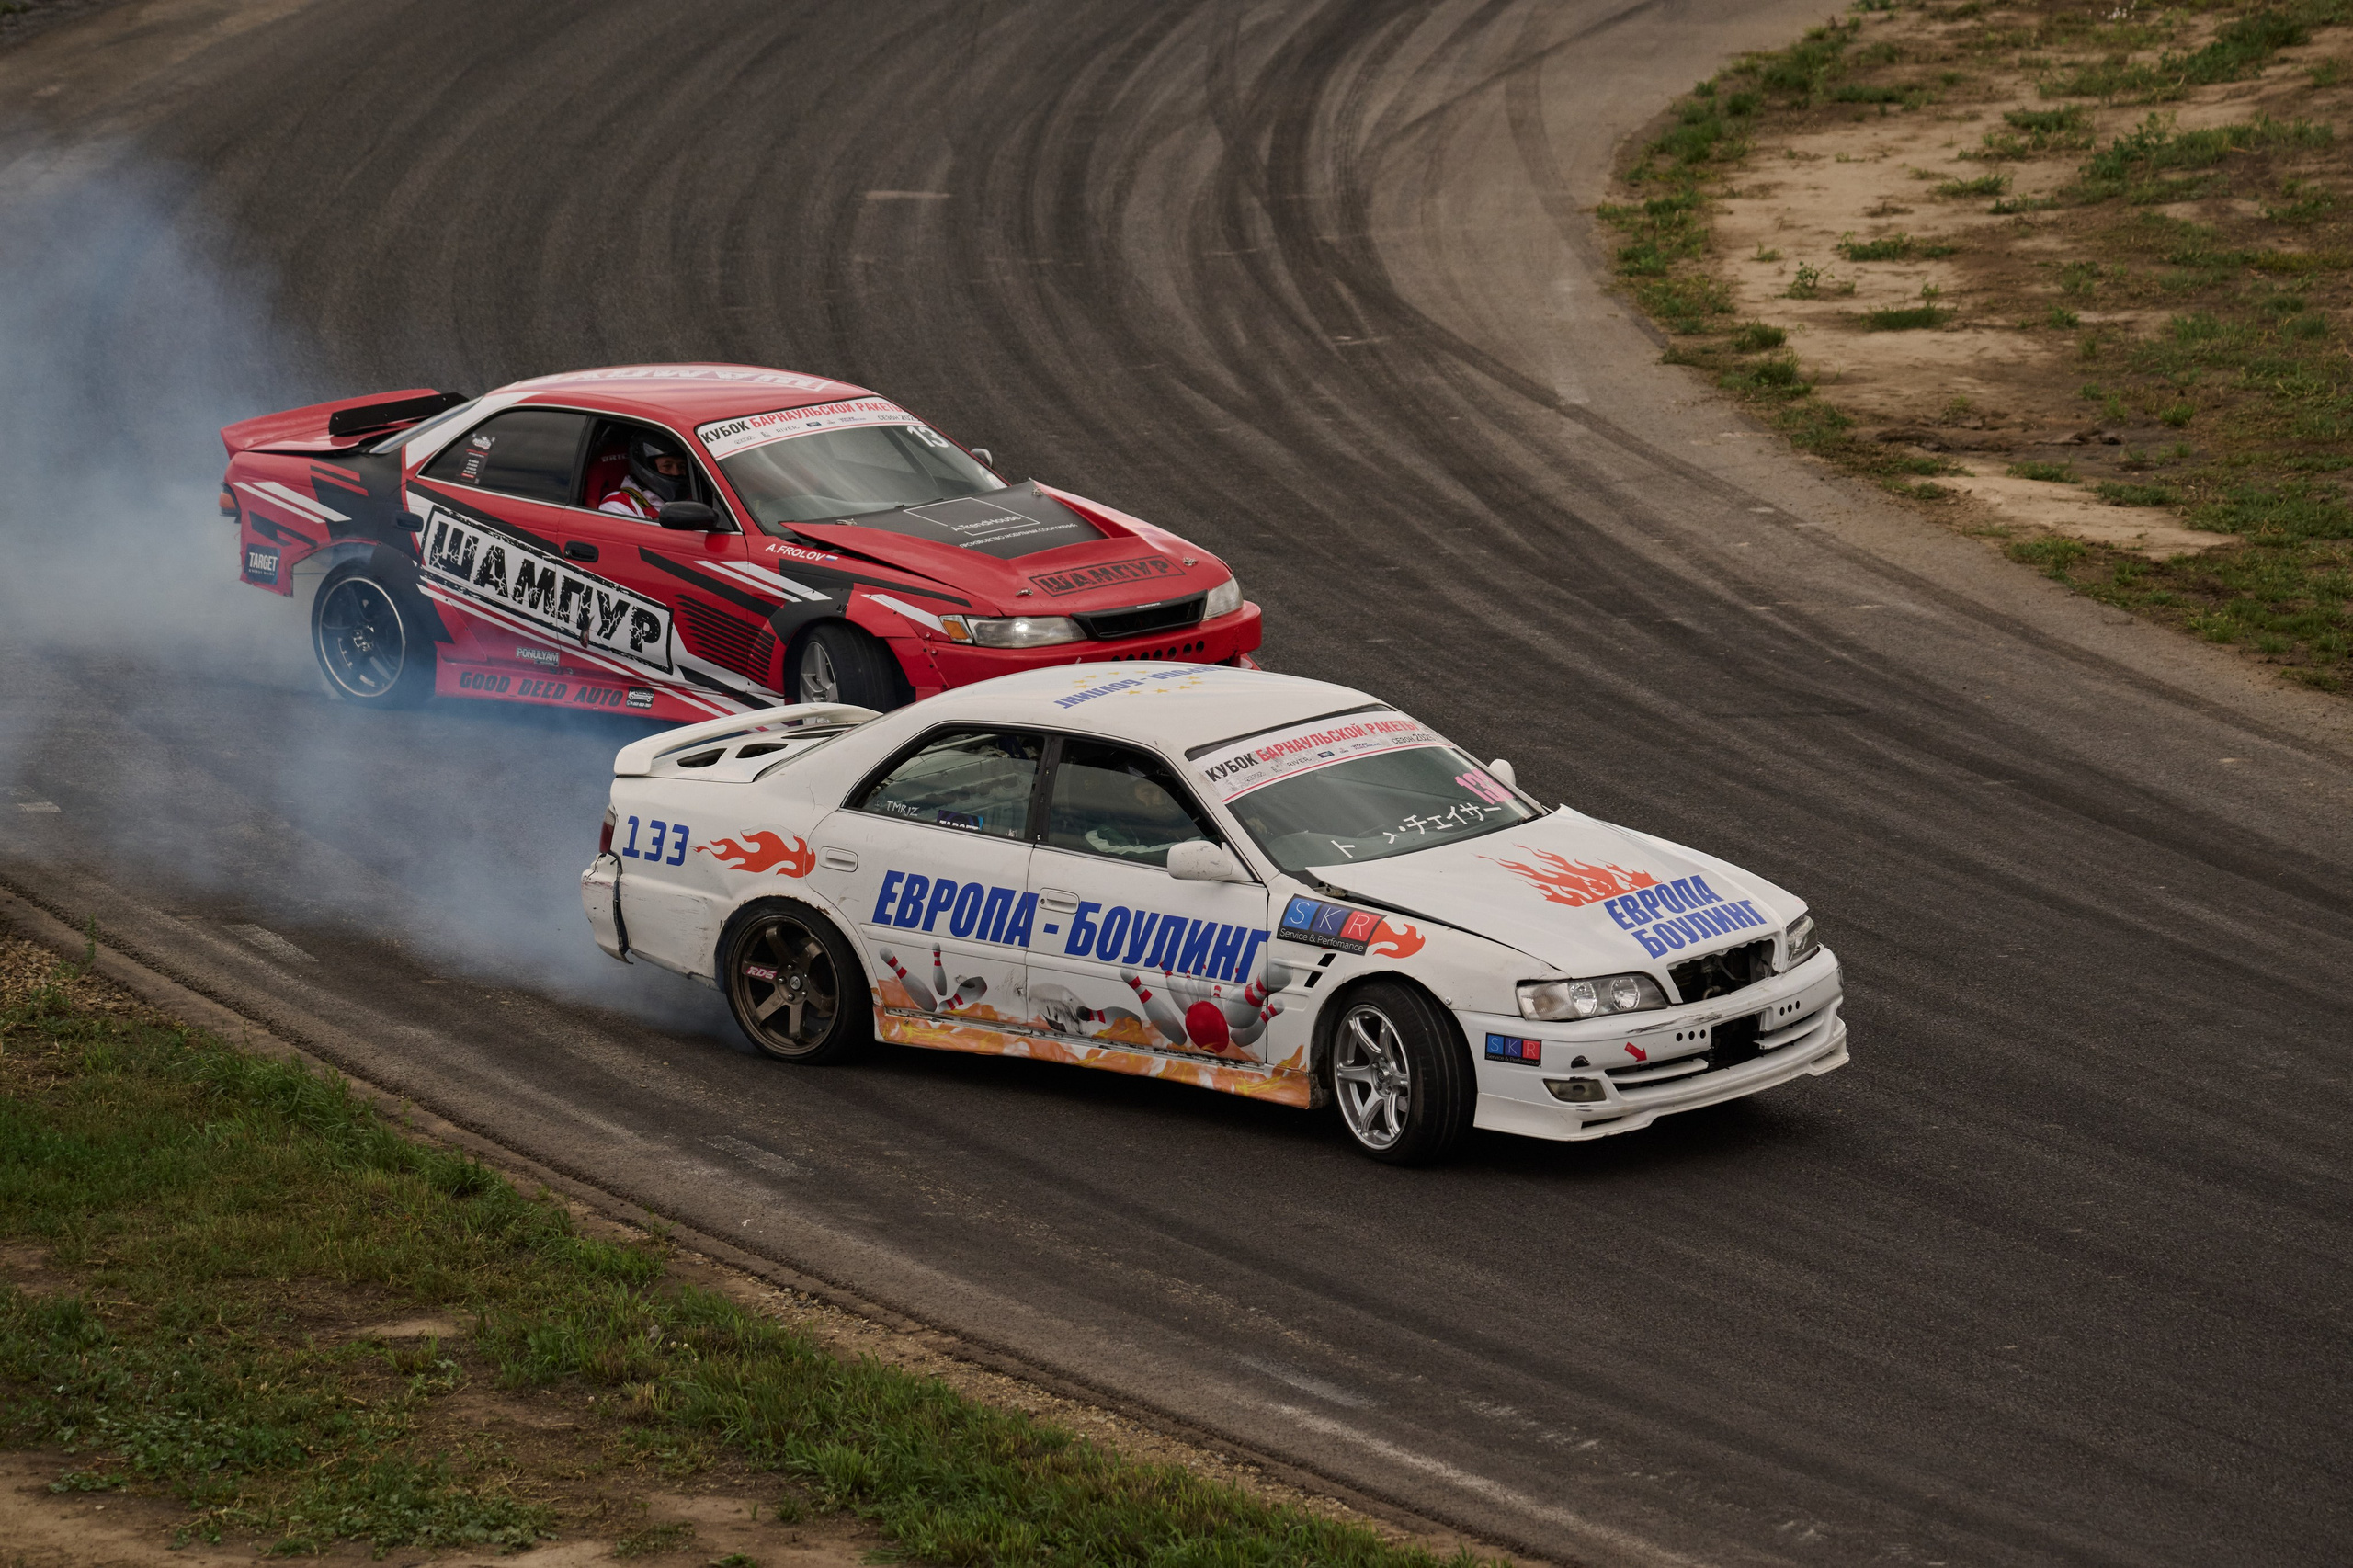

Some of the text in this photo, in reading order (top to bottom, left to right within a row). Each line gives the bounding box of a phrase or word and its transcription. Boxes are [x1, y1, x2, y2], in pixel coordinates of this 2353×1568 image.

[700, 421, 750, 444] КУБОК
[749, 402, 854, 428] БАРНАУЛЬСКОЙ
[907, 426, 949, 448] 13
[249, 551, 278, 571] TARGET
[765, 543, 826, 561] A.FROLOV
[429, 520, 661, 653] ШАМПУР
[1039, 559, 1169, 593] ШАМПУР
[1205, 720, 1417, 782] КУБОК БАРНАУЛЬСКОЙ РАКЕТЫ
[1392, 735, 1414, 744] СЕЗОН
[622, 815, 689, 866] 133
[1603, 874, 1724, 930] ЕВРОПА
[871, 869, 1040, 948] ЕВРОПА
[1063, 900, 1272, 983] БОУЛИНГ
[1279, 927, 1308, 940] Service
[1309, 934, 1316, 942] &
[1290, 902, 1370, 937] SKR
[1631, 900, 1768, 960] БОУЛИНГ
[747, 966, 778, 980] RDS
[1490, 1038, 1535, 1057] SKR
